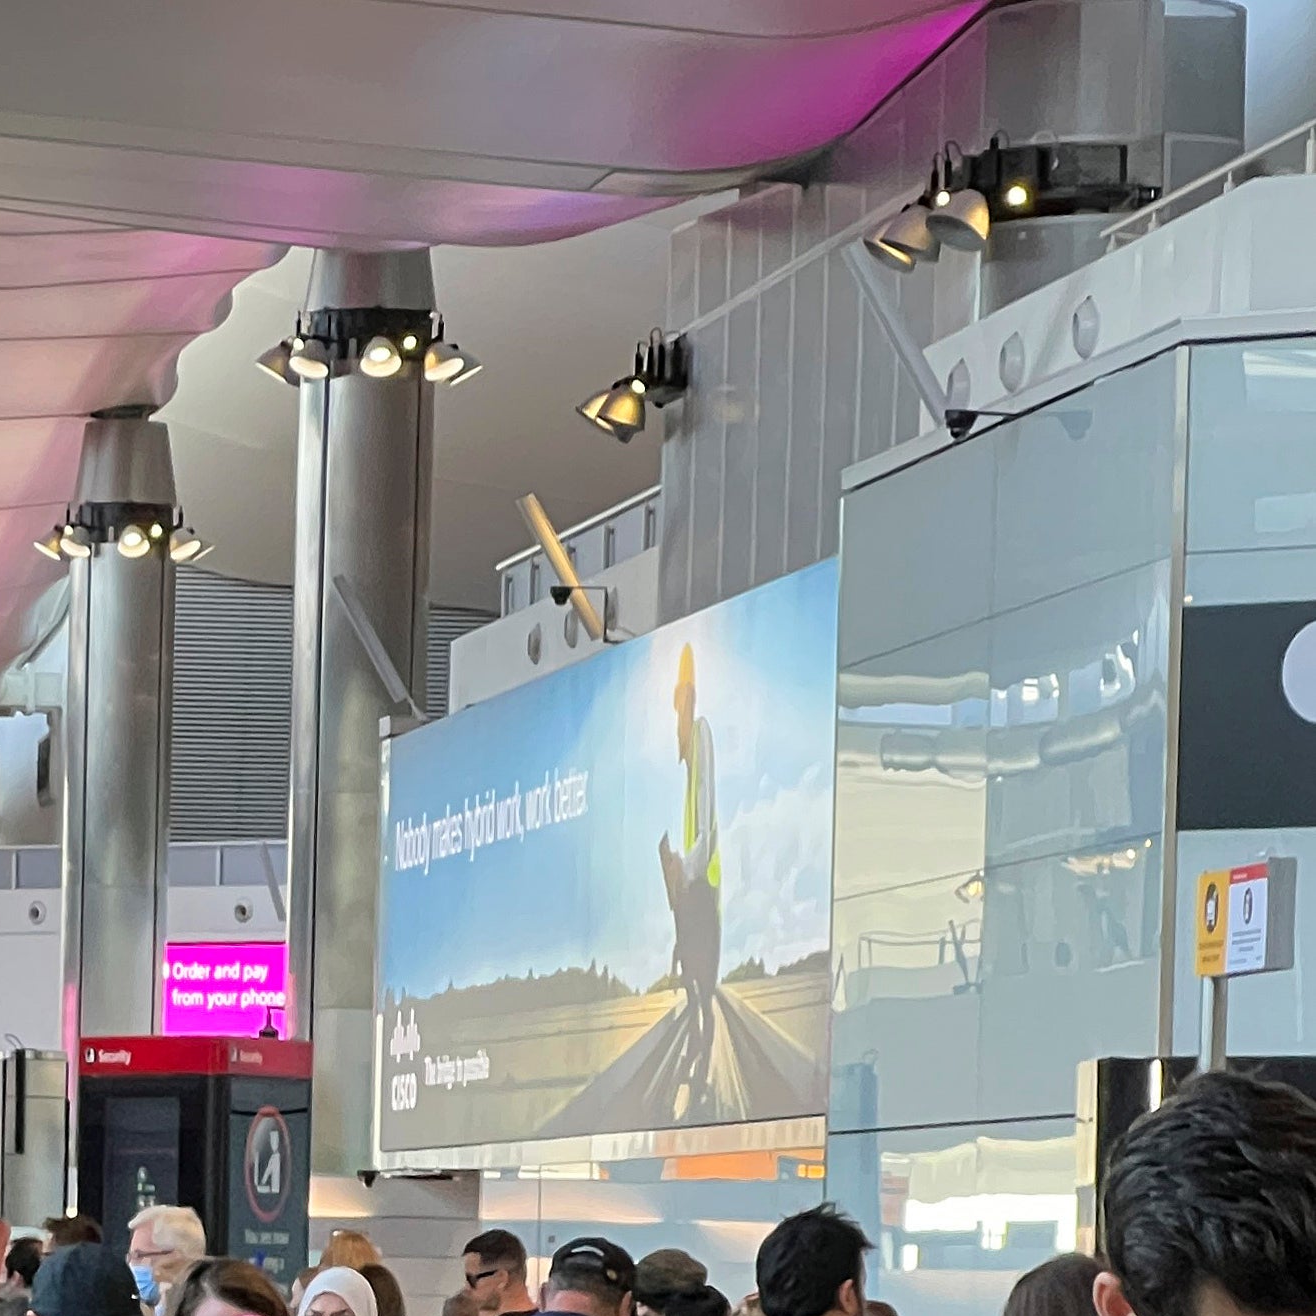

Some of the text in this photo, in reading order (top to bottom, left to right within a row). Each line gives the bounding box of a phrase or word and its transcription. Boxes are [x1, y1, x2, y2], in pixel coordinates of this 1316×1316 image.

[394, 812, 431, 876] Nobody
[431, 803, 463, 860] makes
[464, 789, 496, 862] hybrid
[525, 770, 552, 831] work
[172, 961, 269, 983] Order and pay
[172, 987, 286, 1010] from your phone
